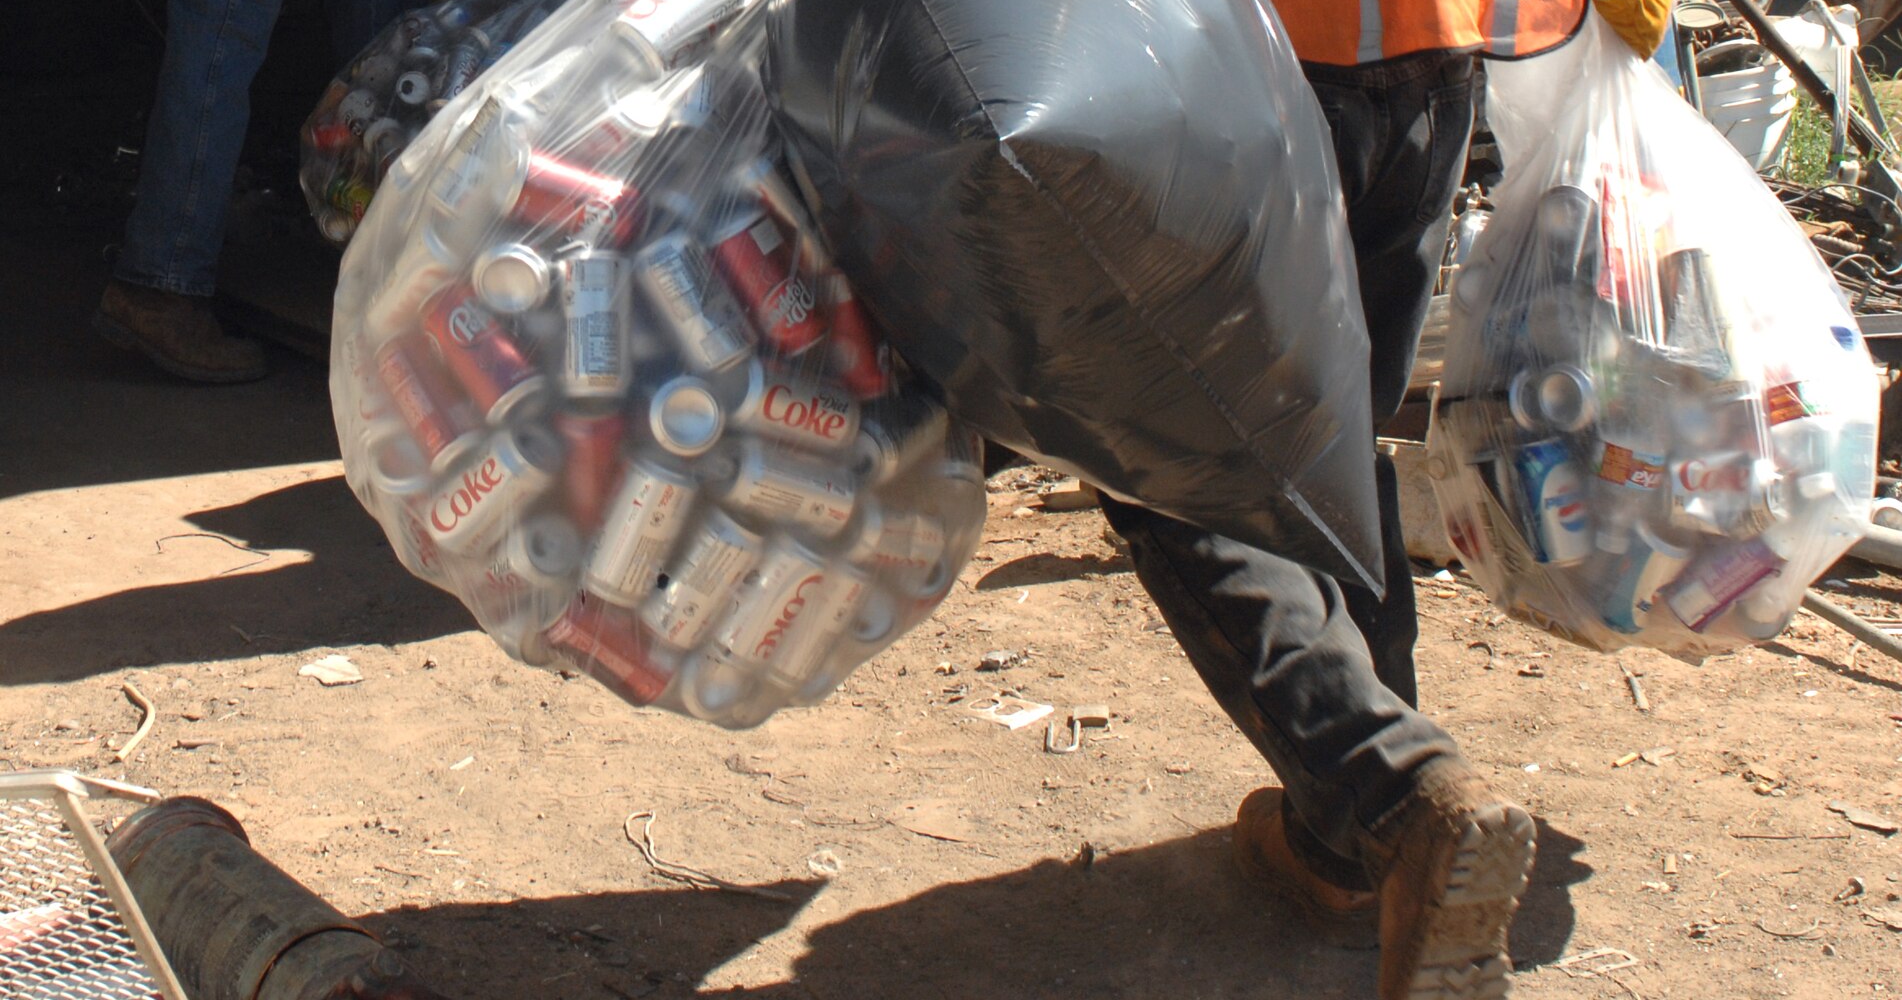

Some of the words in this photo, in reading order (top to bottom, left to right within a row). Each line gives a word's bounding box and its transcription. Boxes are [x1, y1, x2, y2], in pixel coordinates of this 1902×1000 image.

[763, 384, 846, 440] Coke
[818, 393, 849, 414] Diet
[430, 457, 505, 533] Coke
